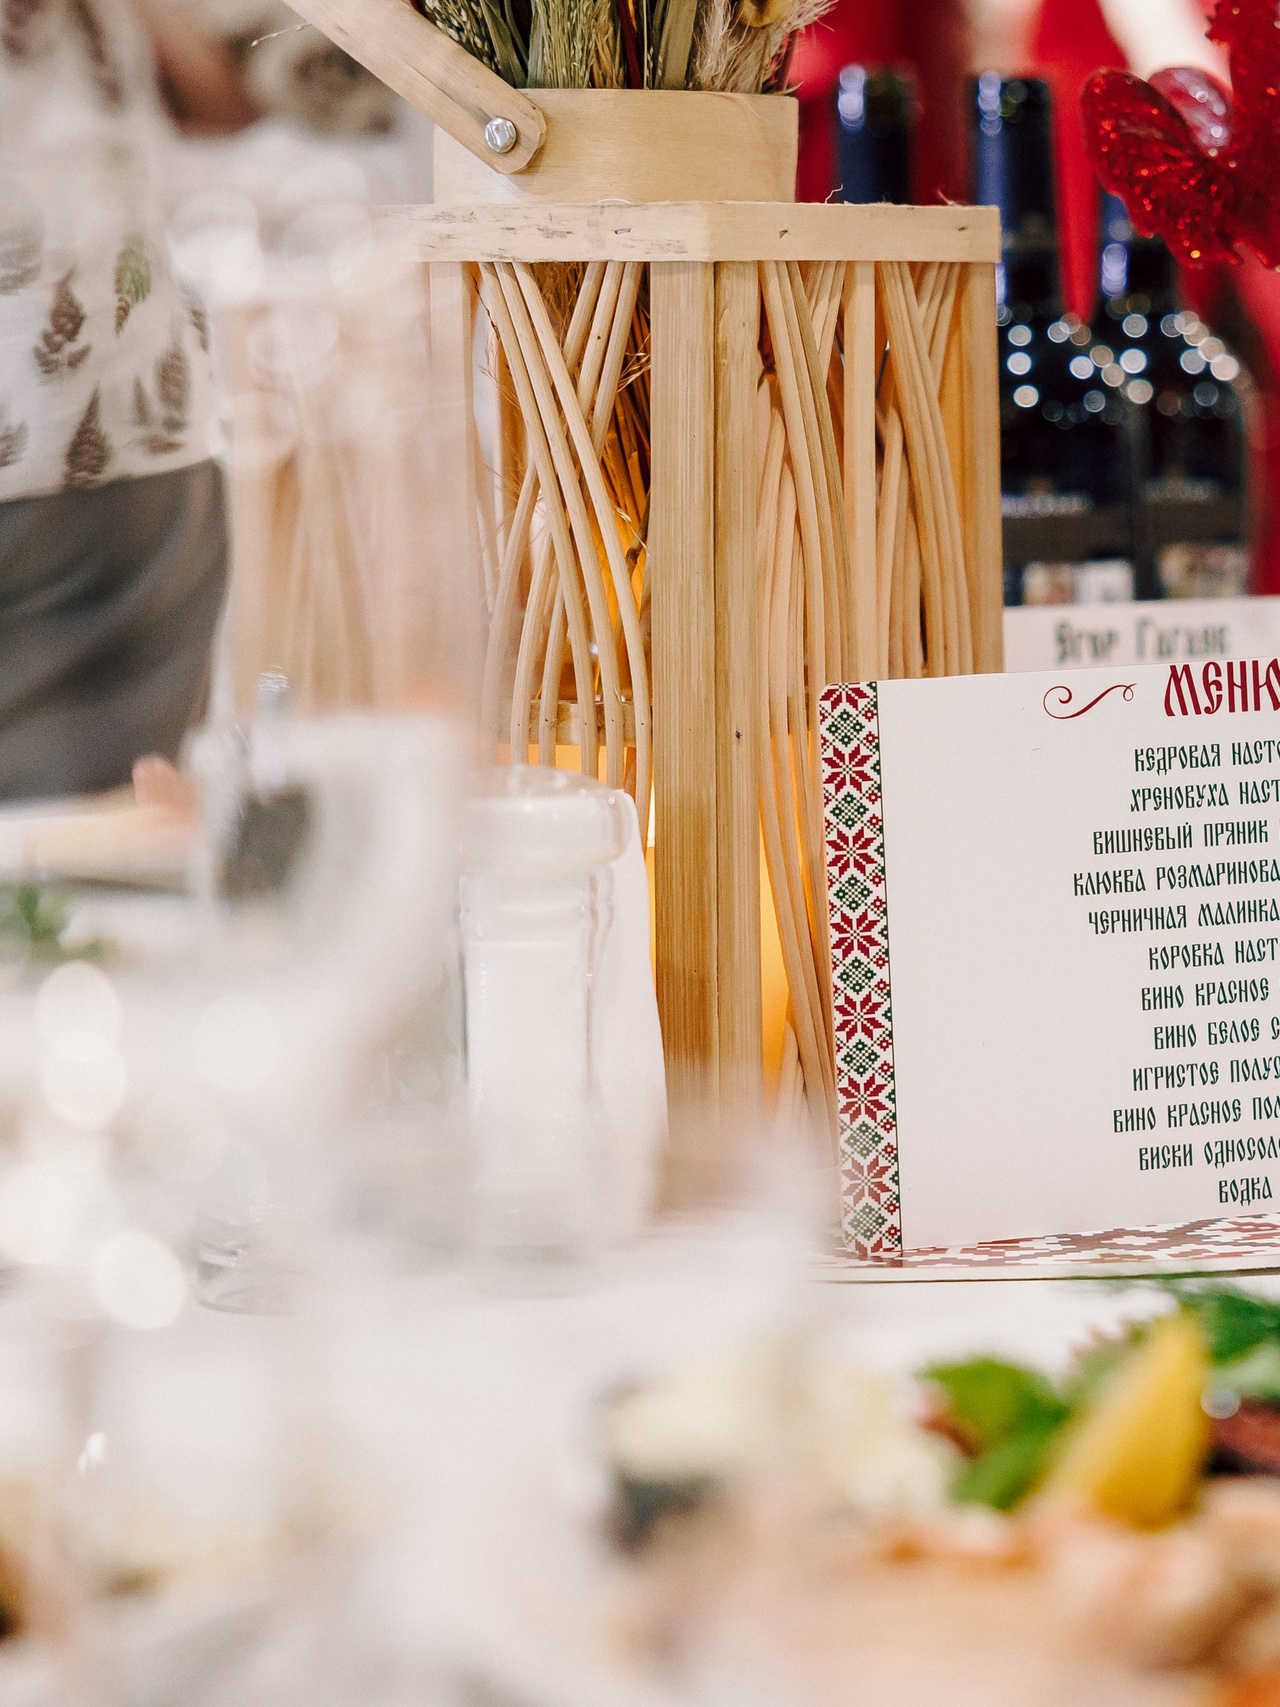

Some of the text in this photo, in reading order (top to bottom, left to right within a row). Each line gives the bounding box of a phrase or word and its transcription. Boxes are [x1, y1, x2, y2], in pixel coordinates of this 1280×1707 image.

[1135, 744, 1221, 776] КЕДРОВАЯ
[1131, 783, 1229, 812] ХРЕНОВУХА
[1093, 822, 1192, 855] ВИШНЕВЫЙ
[1204, 820, 1268, 847] ПРЯНИК
[1074, 869, 1146, 896] КЛЮКВА
[1089, 905, 1187, 935] ЧЕРНИЧНАЯ
[1198, 898, 1280, 927] МАЛИНКА
[1149, 942, 1225, 970] КОРОВКА
[1142, 985, 1184, 1011] ВИНО
[1195, 978, 1269, 1006] КРАСНОЕ
[1154, 1024, 1196, 1050] ВИНО
[1208, 1018, 1259, 1045] БЕЛОЕ
[1133, 1061, 1219, 1091] ИГРИСТОЕ
[1113, 1106, 1156, 1133] ВИНО
[1167, 1099, 1241, 1128] КРАСНОЕ
[1139, 1143, 1193, 1170] ВИСКИ
[1219, 1176, 1272, 1206] ВОДКА
